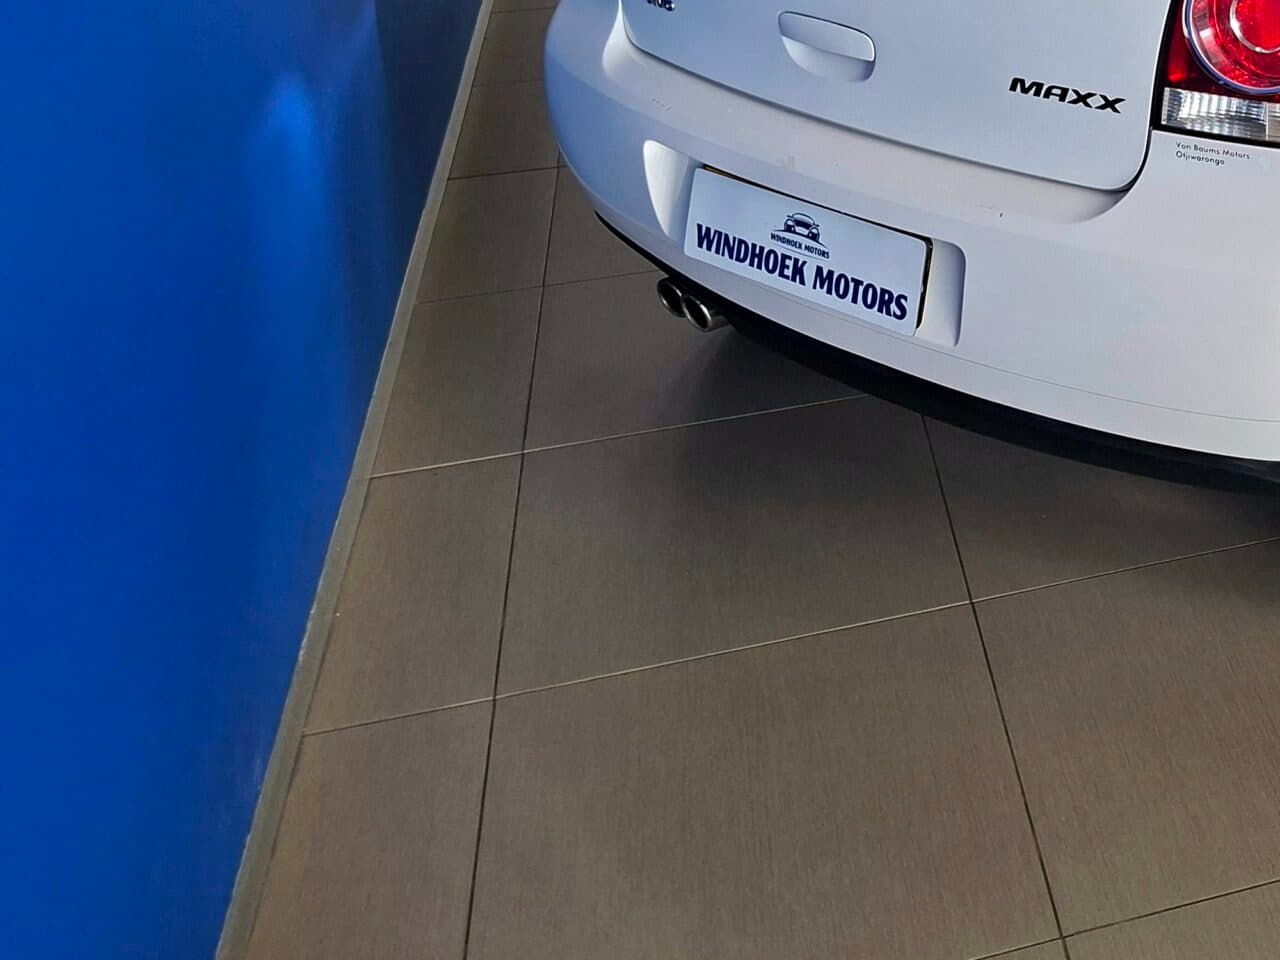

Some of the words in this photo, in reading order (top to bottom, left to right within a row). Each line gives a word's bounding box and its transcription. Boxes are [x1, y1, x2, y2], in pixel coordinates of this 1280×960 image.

[1008, 77, 1126, 114] MAXX
[770, 232, 803, 250] WINDHOEK
[804, 244, 830, 259] MOTORS
[696, 223, 807, 286] WINDHOEK
[812, 265, 908, 321] MOTORS
